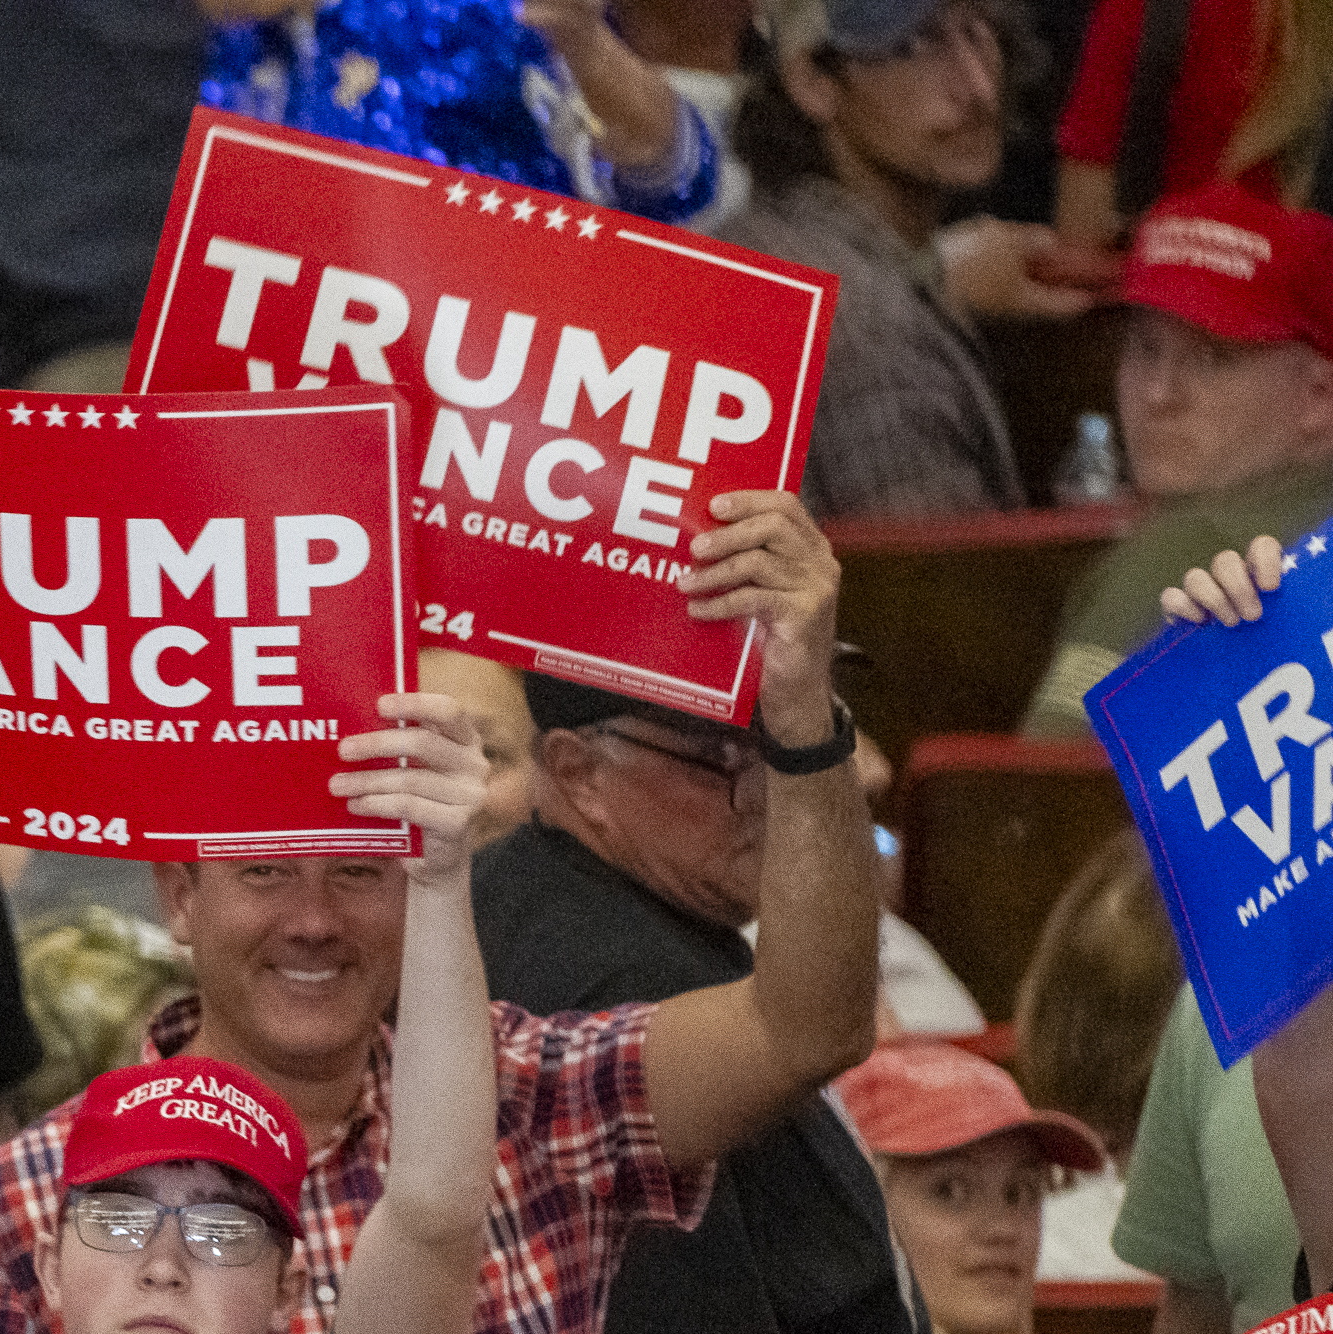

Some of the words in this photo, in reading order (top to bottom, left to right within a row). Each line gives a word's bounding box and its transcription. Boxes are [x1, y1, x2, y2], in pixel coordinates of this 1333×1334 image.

[203, 234, 773, 466] TRUMP
[462, 512, 573, 557] GREAT
[582, 541, 693, 586] AGAIN
[416, 600, 475, 641] 24
[84, 716, 202, 743] GREAT
[212, 716, 338, 744] AGAIN!
[22, 807, 130, 847] 2024
[1236, 855, 1309, 928] MAKE
[113, 1077, 183, 1116] KEEP
[184, 1074, 291, 1161] AMERICA
[159, 1098, 258, 1148] GREAT!
